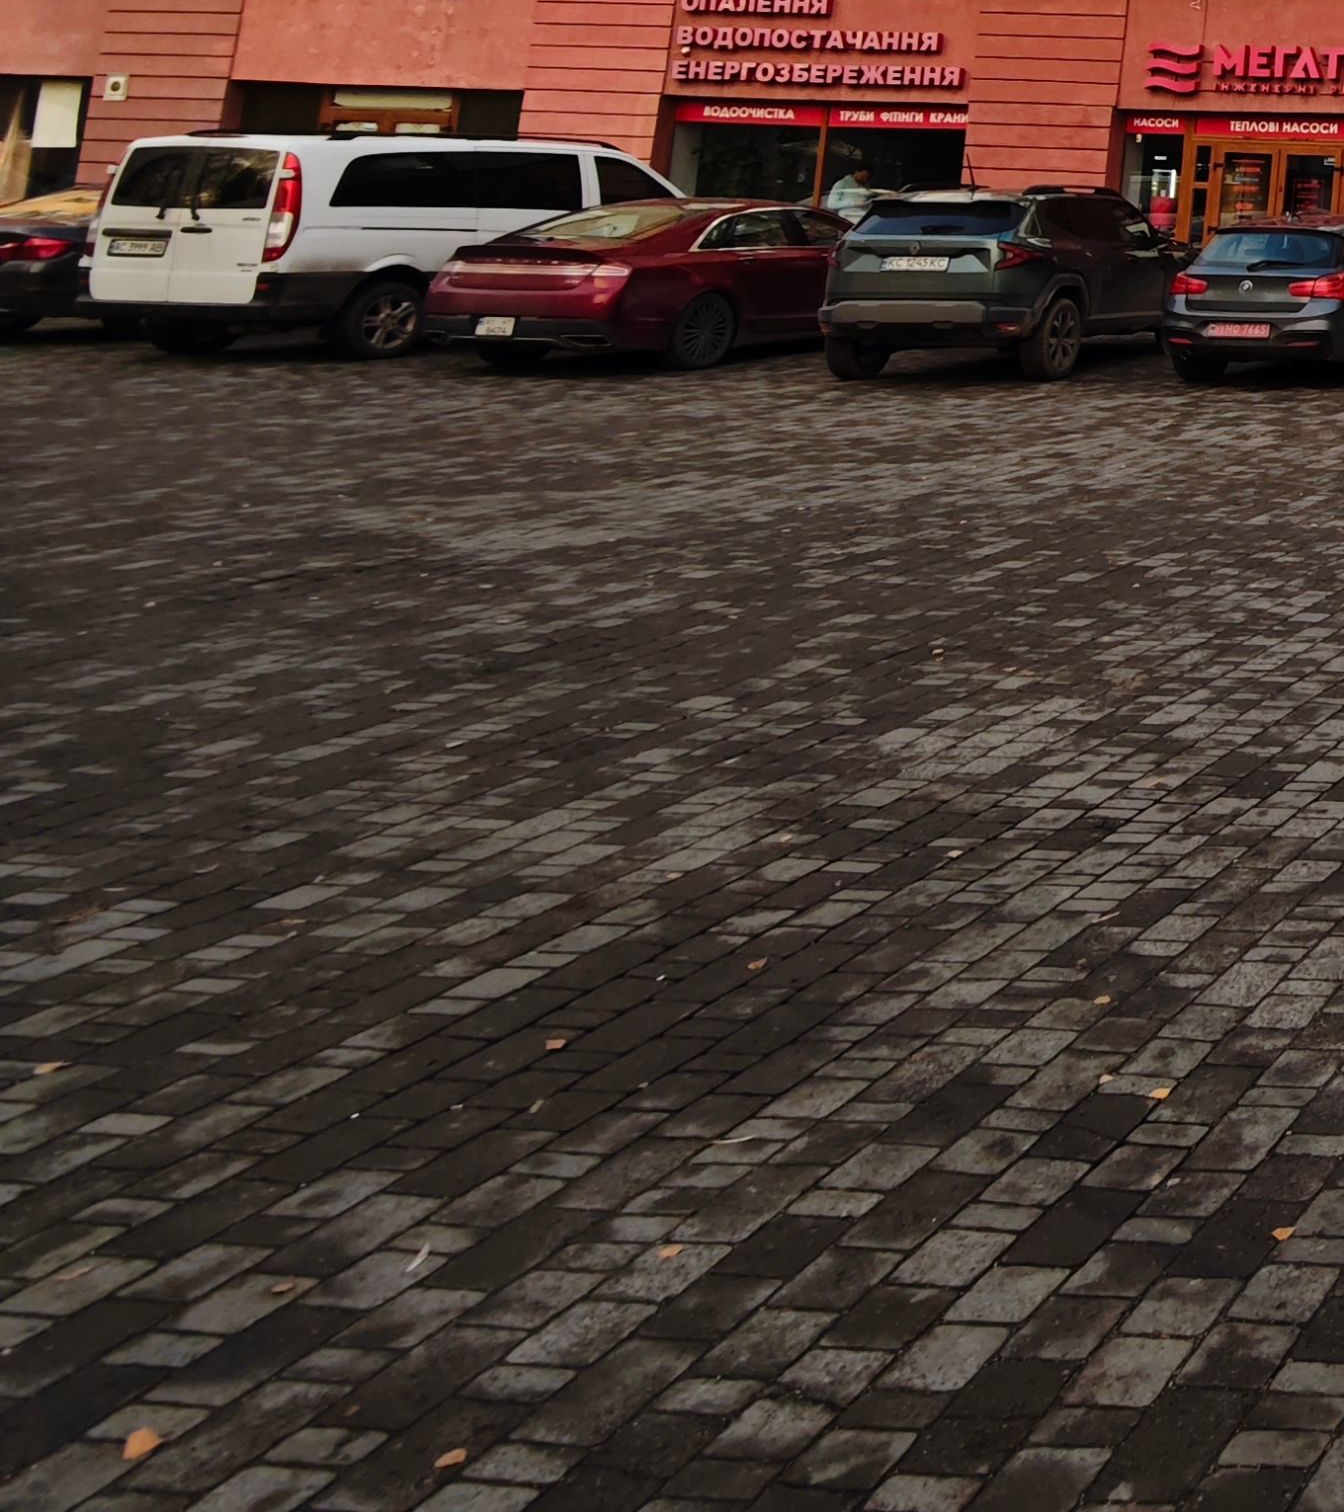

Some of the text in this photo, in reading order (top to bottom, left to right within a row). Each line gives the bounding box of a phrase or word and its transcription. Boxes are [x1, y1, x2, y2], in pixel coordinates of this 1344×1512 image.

[676, 25, 942, 54] ВОДОПОСТАЧАННЯ
[671, 58, 964, 88] ЕНЕРГОЗБЕРЕЖЕННЯ
[703, 104, 795, 121] ВОДООЧИСТКА
[839, 109, 875, 124] ТРУБИ
[880, 110, 924, 125] ФІТІНГИ
[1133, 116, 1179, 129] НАСОСИ
[1229, 120, 1338, 135] ТЕПЛОВІ НАСОСИ
